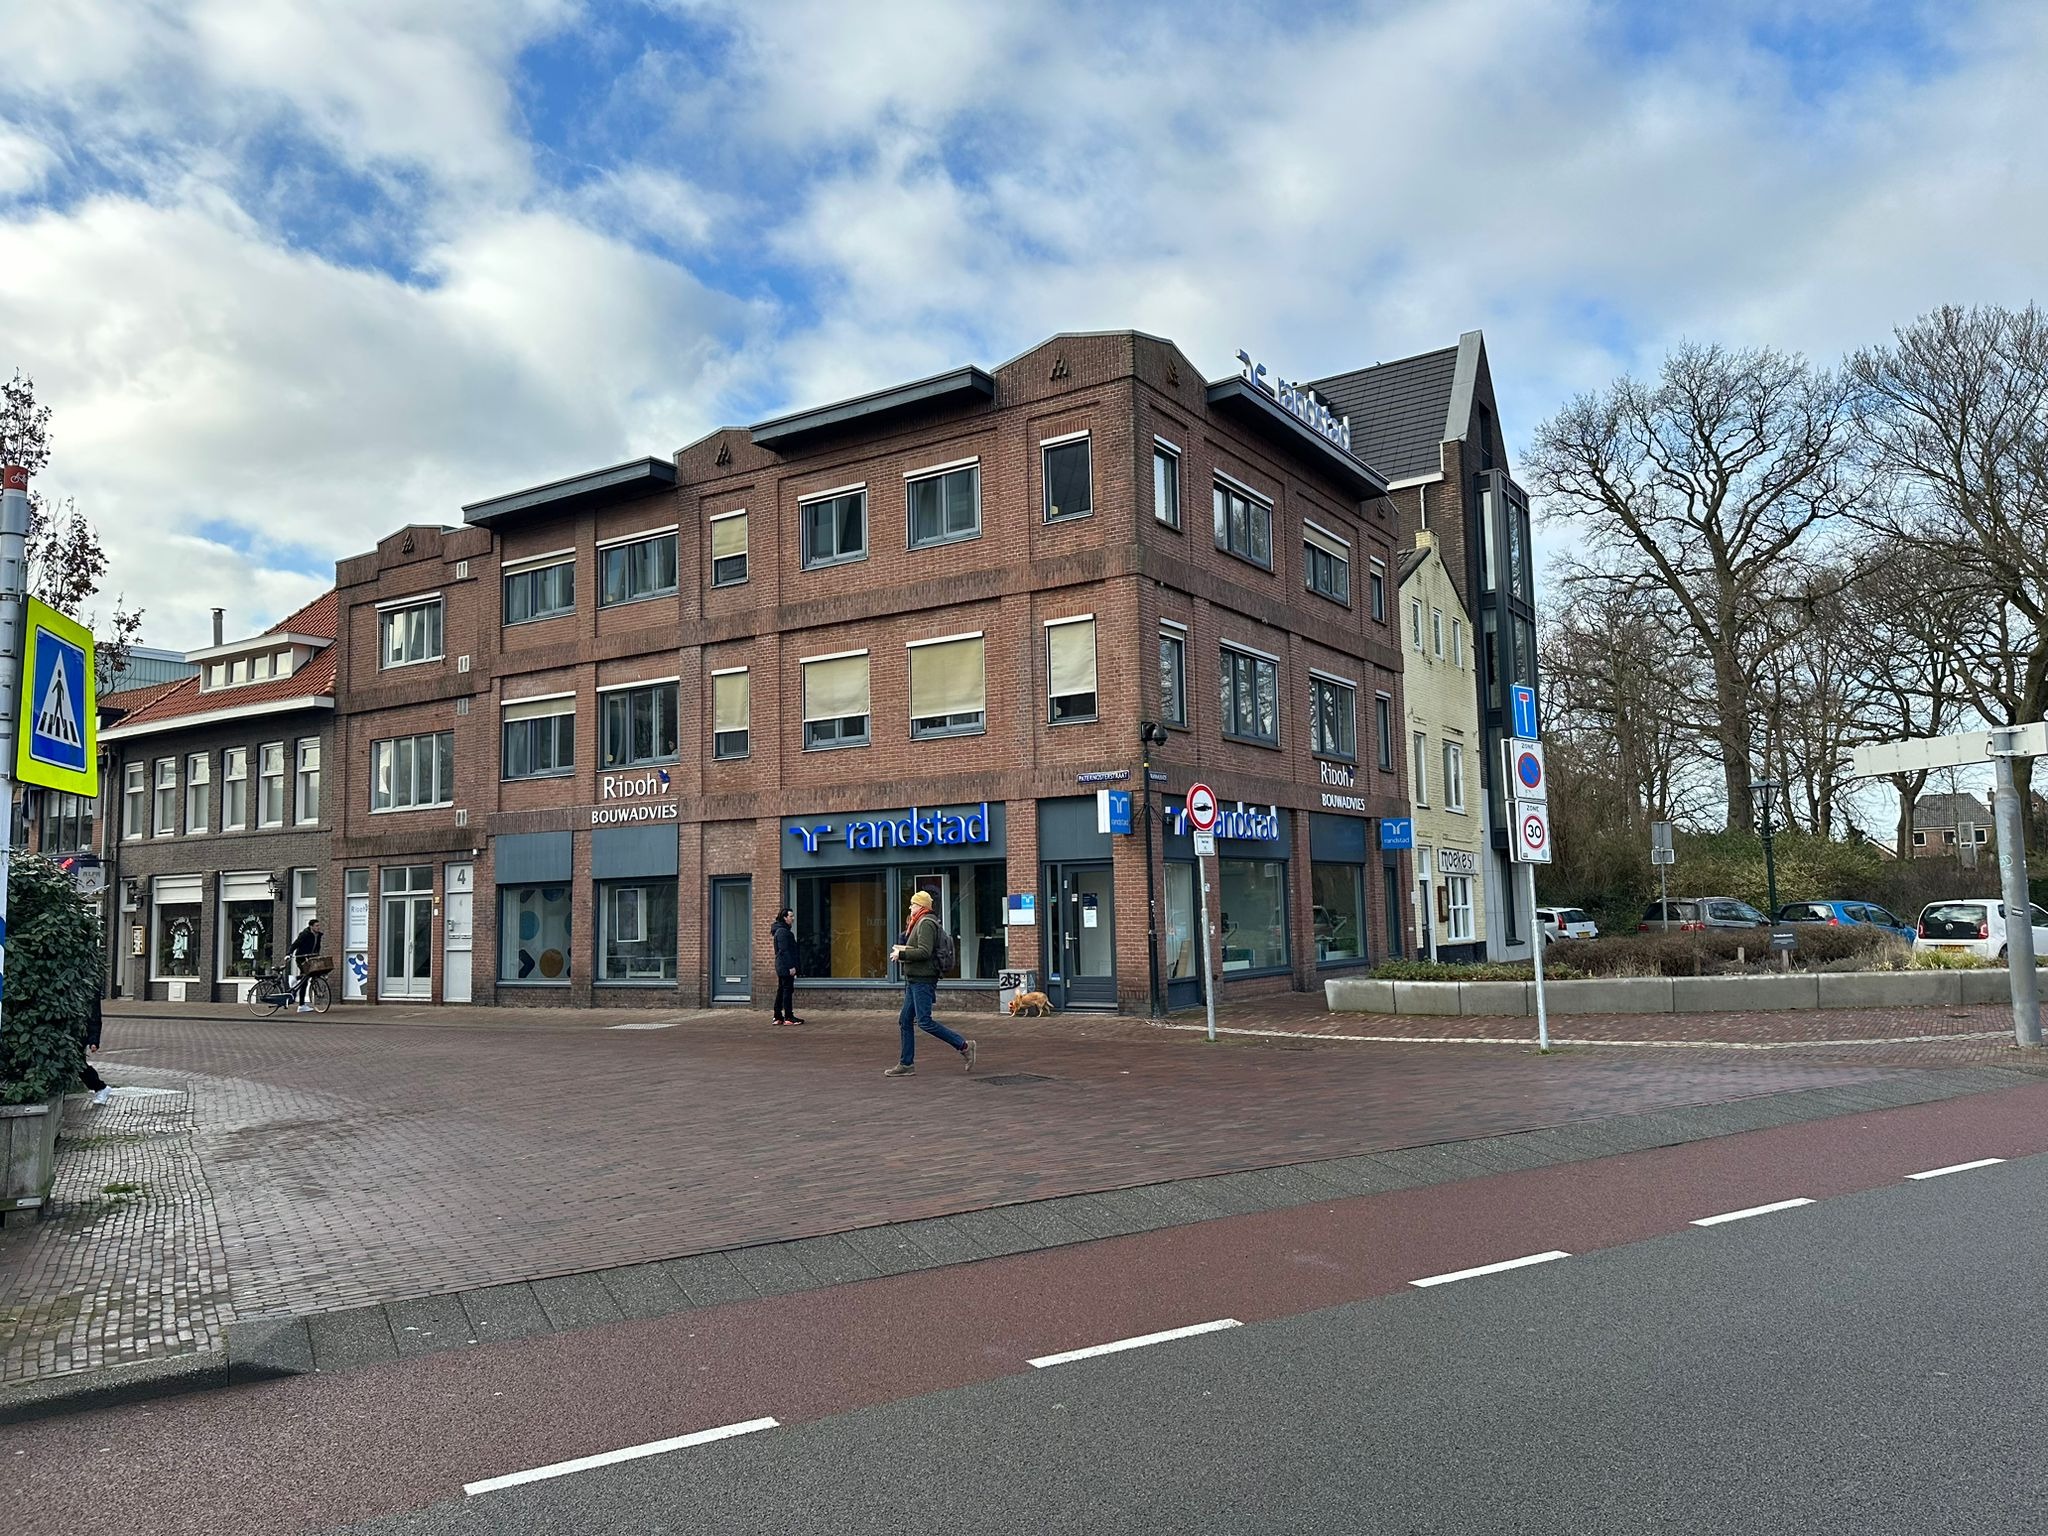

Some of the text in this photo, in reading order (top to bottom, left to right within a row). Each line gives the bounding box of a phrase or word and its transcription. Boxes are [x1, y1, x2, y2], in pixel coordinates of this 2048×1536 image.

[1274, 377, 1350, 452] randstad
[1321, 794, 1365, 811] BOUWADVIES
[1526, 804, 1540, 812] ZONE
[591, 804, 677, 824] BOUWADVIES
[1212, 801, 1280, 840] andstad
[845, 802, 989, 849] randstad
[1527, 824, 1542, 839] 30
[457, 869, 466, 885] 4
